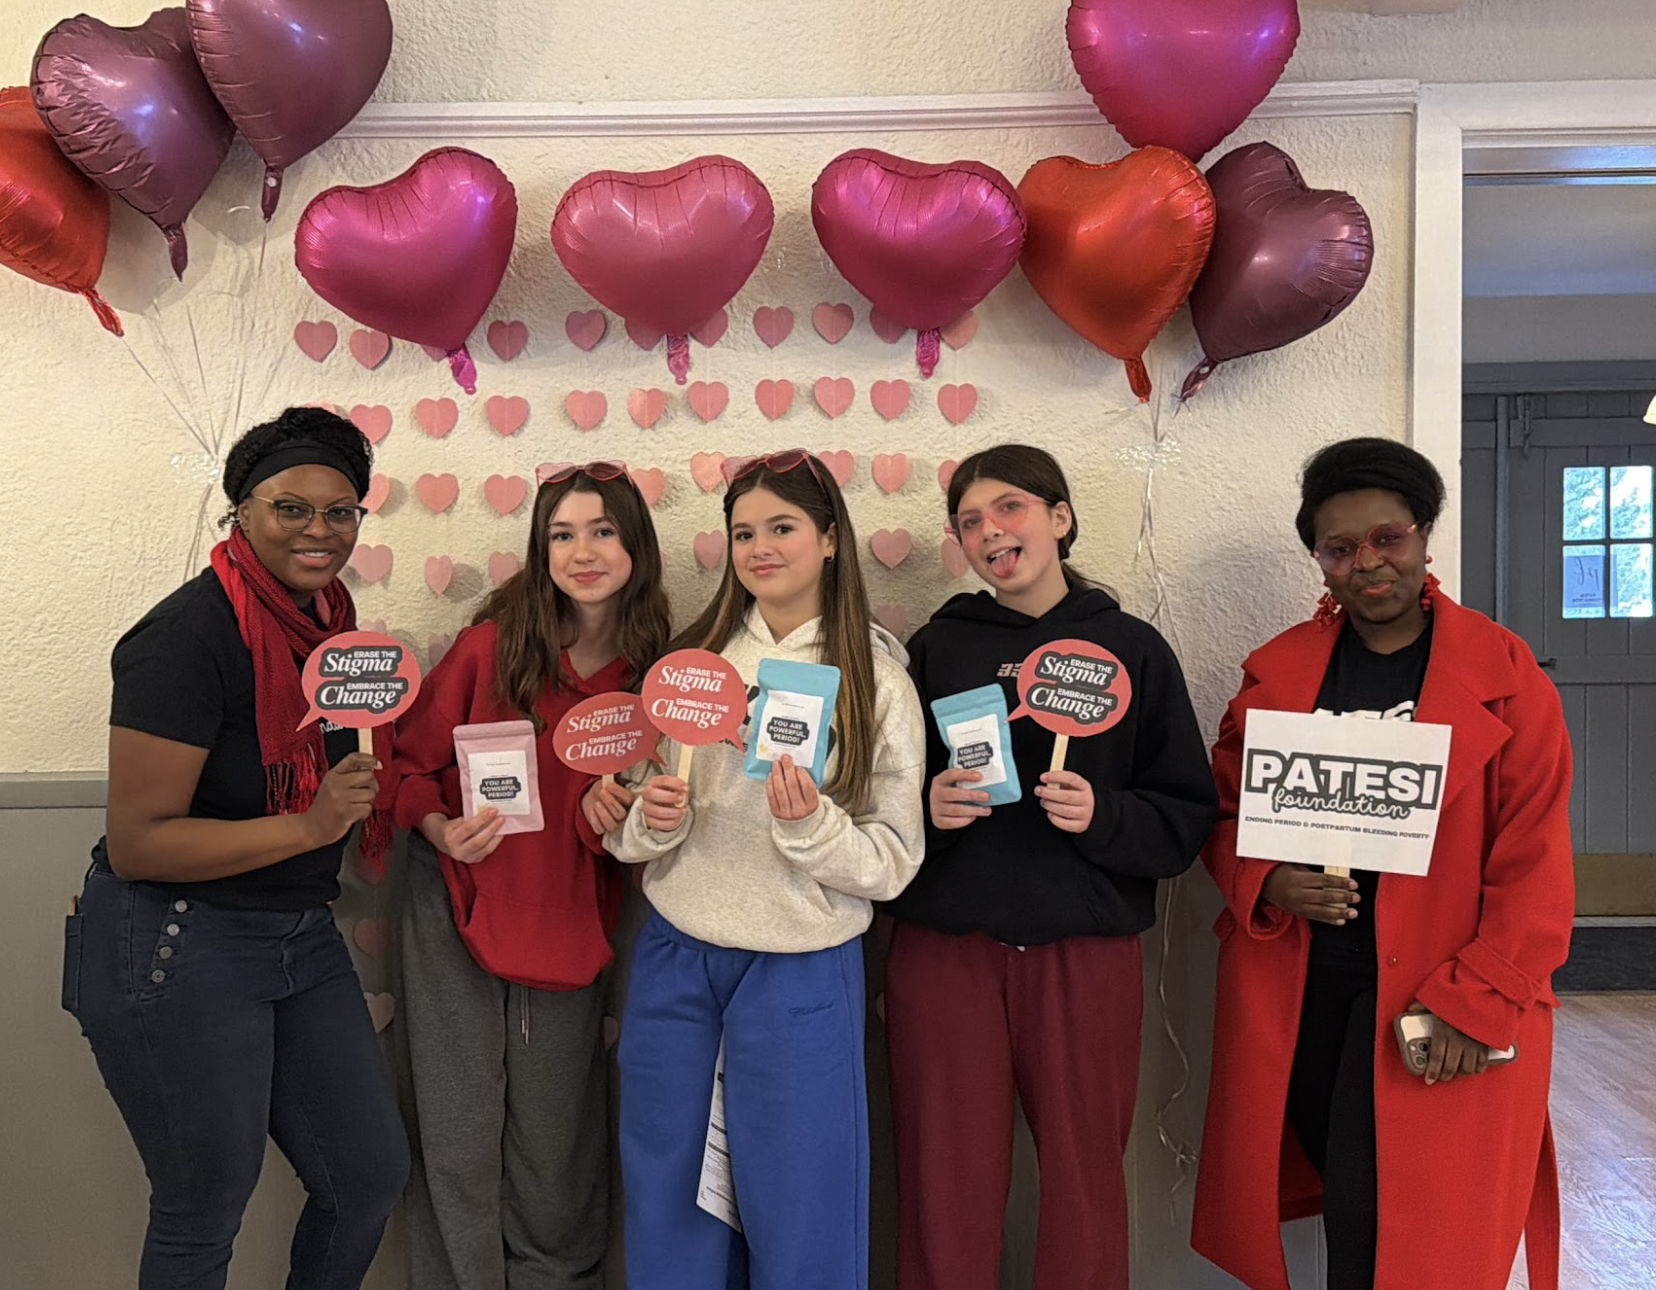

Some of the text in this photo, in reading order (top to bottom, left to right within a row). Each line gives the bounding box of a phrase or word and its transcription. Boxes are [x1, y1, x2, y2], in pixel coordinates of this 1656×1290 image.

[324, 653, 393, 677] Stigma
[353, 650, 397, 659] ERASE THE
[686, 667, 727, 680] ERASE THE
[1040, 656, 1107, 686] Stigma
[1070, 659, 1113, 674] ERASE THE
[346, 682, 403, 690] EMBRACE THE
[658, 665, 723, 692] Stigma
[320, 685, 397, 709] Change
[675, 698, 730, 713] EMBRACE THE
[1031, 687, 1104, 720] Change
[1057, 688, 1113, 706] EMBRACE THE
[593, 704, 635, 717] ERASE THE
[651, 698, 722, 729] Change
[567, 711, 631, 733] Stigma
[773, 719, 803, 730] YOU ARE
[588, 730, 643, 745] EMBRACE THE
[773, 733, 800, 744] PERIOD!
[565, 738, 637, 761] Change
[1249, 752, 1439, 807] PATESI
[1271, 787, 1411, 819] foundation
[1244, 815, 1274, 824] ENDING
[1274, 818, 1302, 827] PERIOD
[1310, 822, 1362, 833] POSTPARTUM
[1362, 827, 1398, 837] BLEEDING
[1399, 831, 1430, 840] POVERTY
